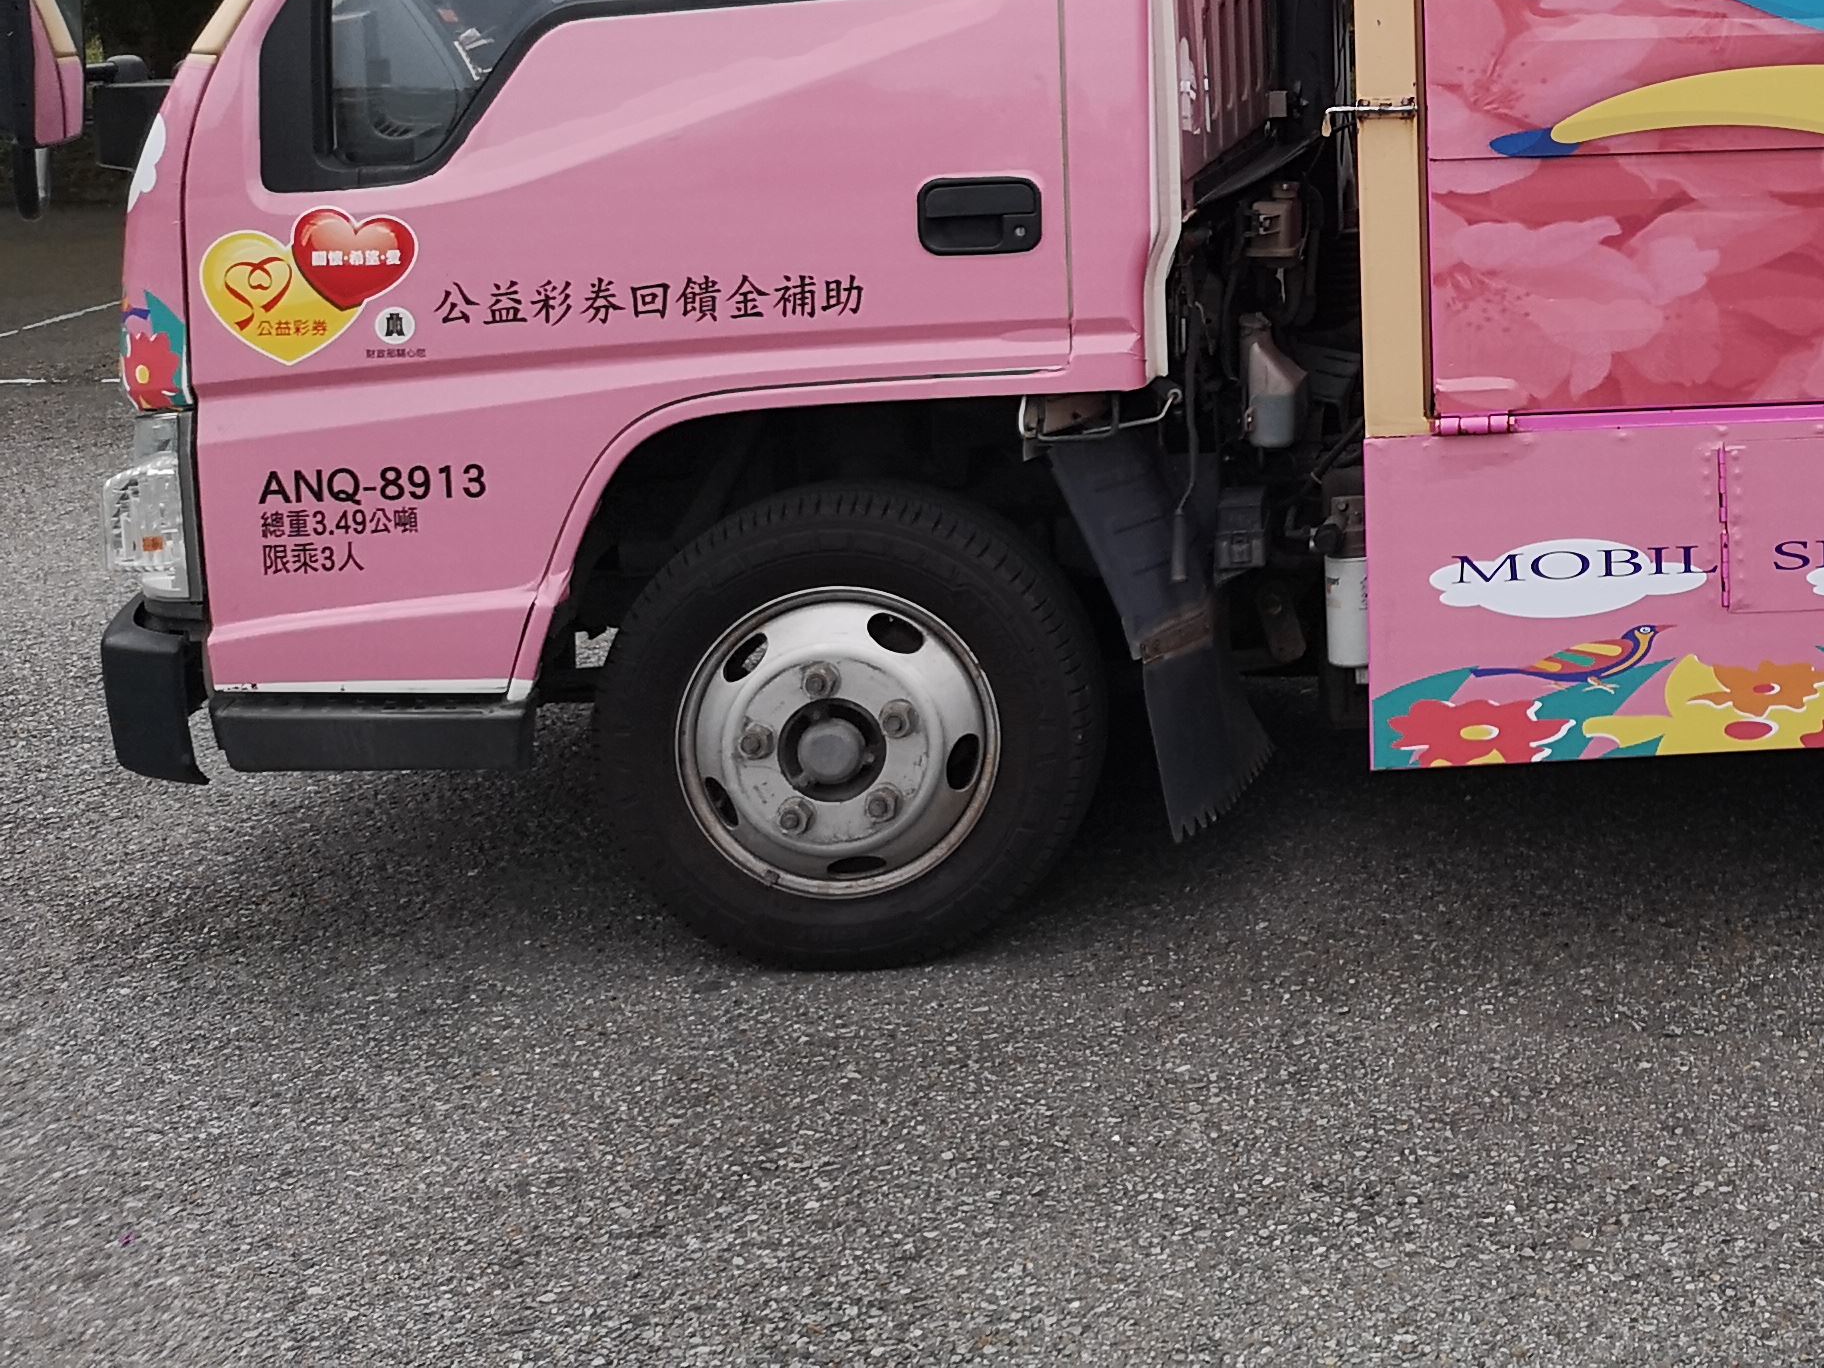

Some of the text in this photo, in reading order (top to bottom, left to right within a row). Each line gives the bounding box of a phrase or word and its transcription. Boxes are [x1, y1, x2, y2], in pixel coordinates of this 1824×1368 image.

[433, 273, 865, 328] 公益彩券回饋金補助
[257, 320, 328, 337] 公益彩券
[258, 463, 487, 506] ANQ-8913
[261, 506, 419, 539] 總重3.49公噸
[262, 541, 365, 575] 限乘3人
